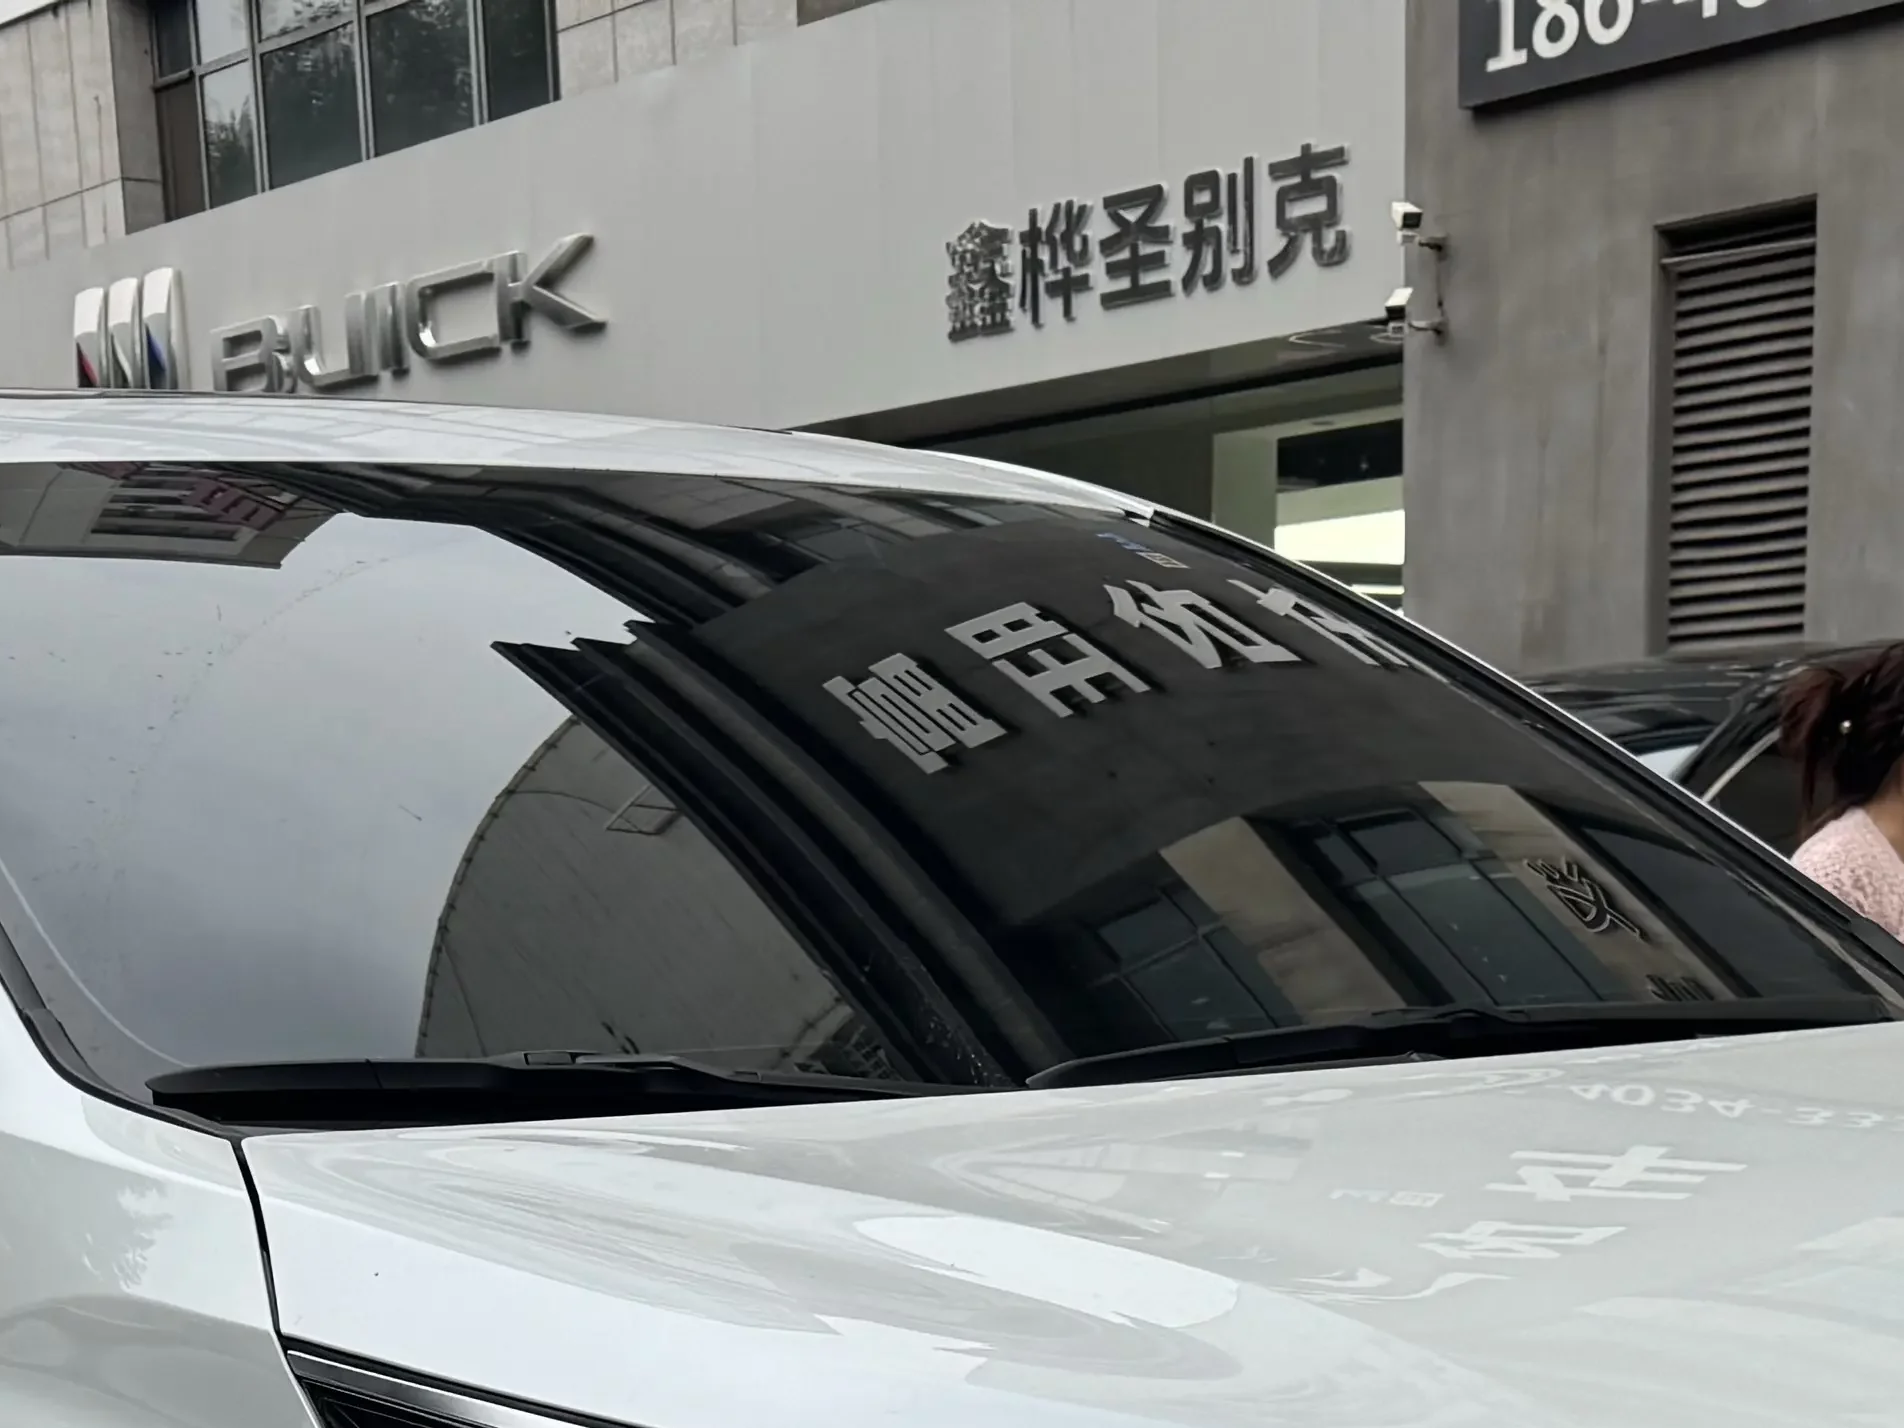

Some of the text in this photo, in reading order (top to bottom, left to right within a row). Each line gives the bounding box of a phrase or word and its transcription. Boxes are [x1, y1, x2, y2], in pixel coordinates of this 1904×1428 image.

[209, 232, 610, 394] BUICK
[945, 141, 1351, 344] 鑫桦圣别克
